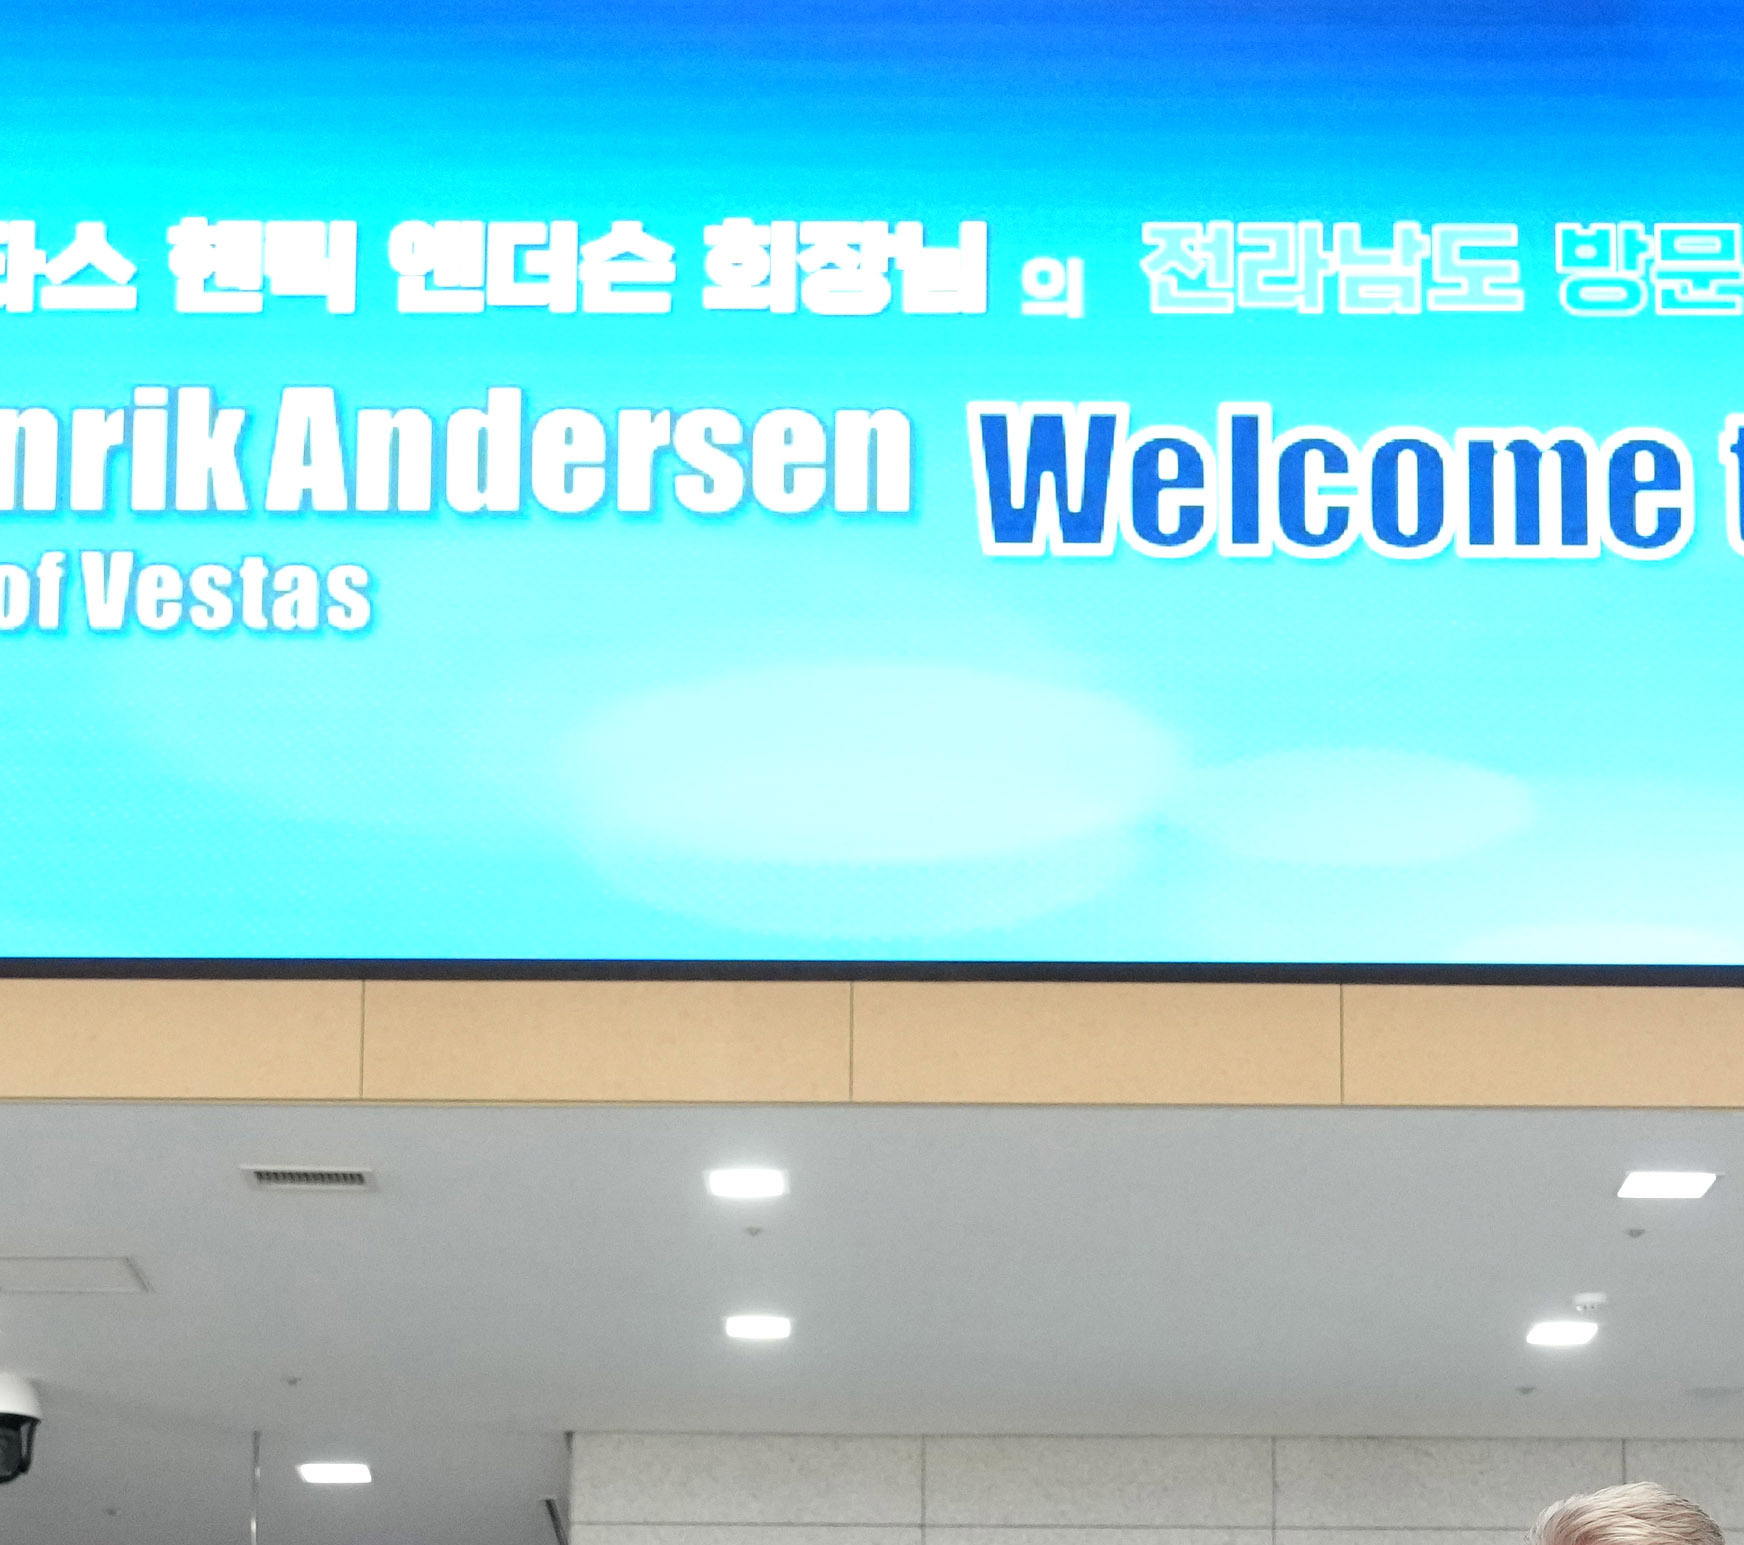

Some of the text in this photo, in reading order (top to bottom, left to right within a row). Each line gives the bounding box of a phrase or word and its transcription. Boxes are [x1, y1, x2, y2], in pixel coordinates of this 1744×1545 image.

[703, 218, 987, 315] 회장님
[1022, 257, 1084, 318] 의
[1141, 222, 1523, 314] 전라남도
[266, 388, 909, 511] Andersen
[981, 416, 1681, 548] Welcome
[81, 551, 370, 629] Vestas
